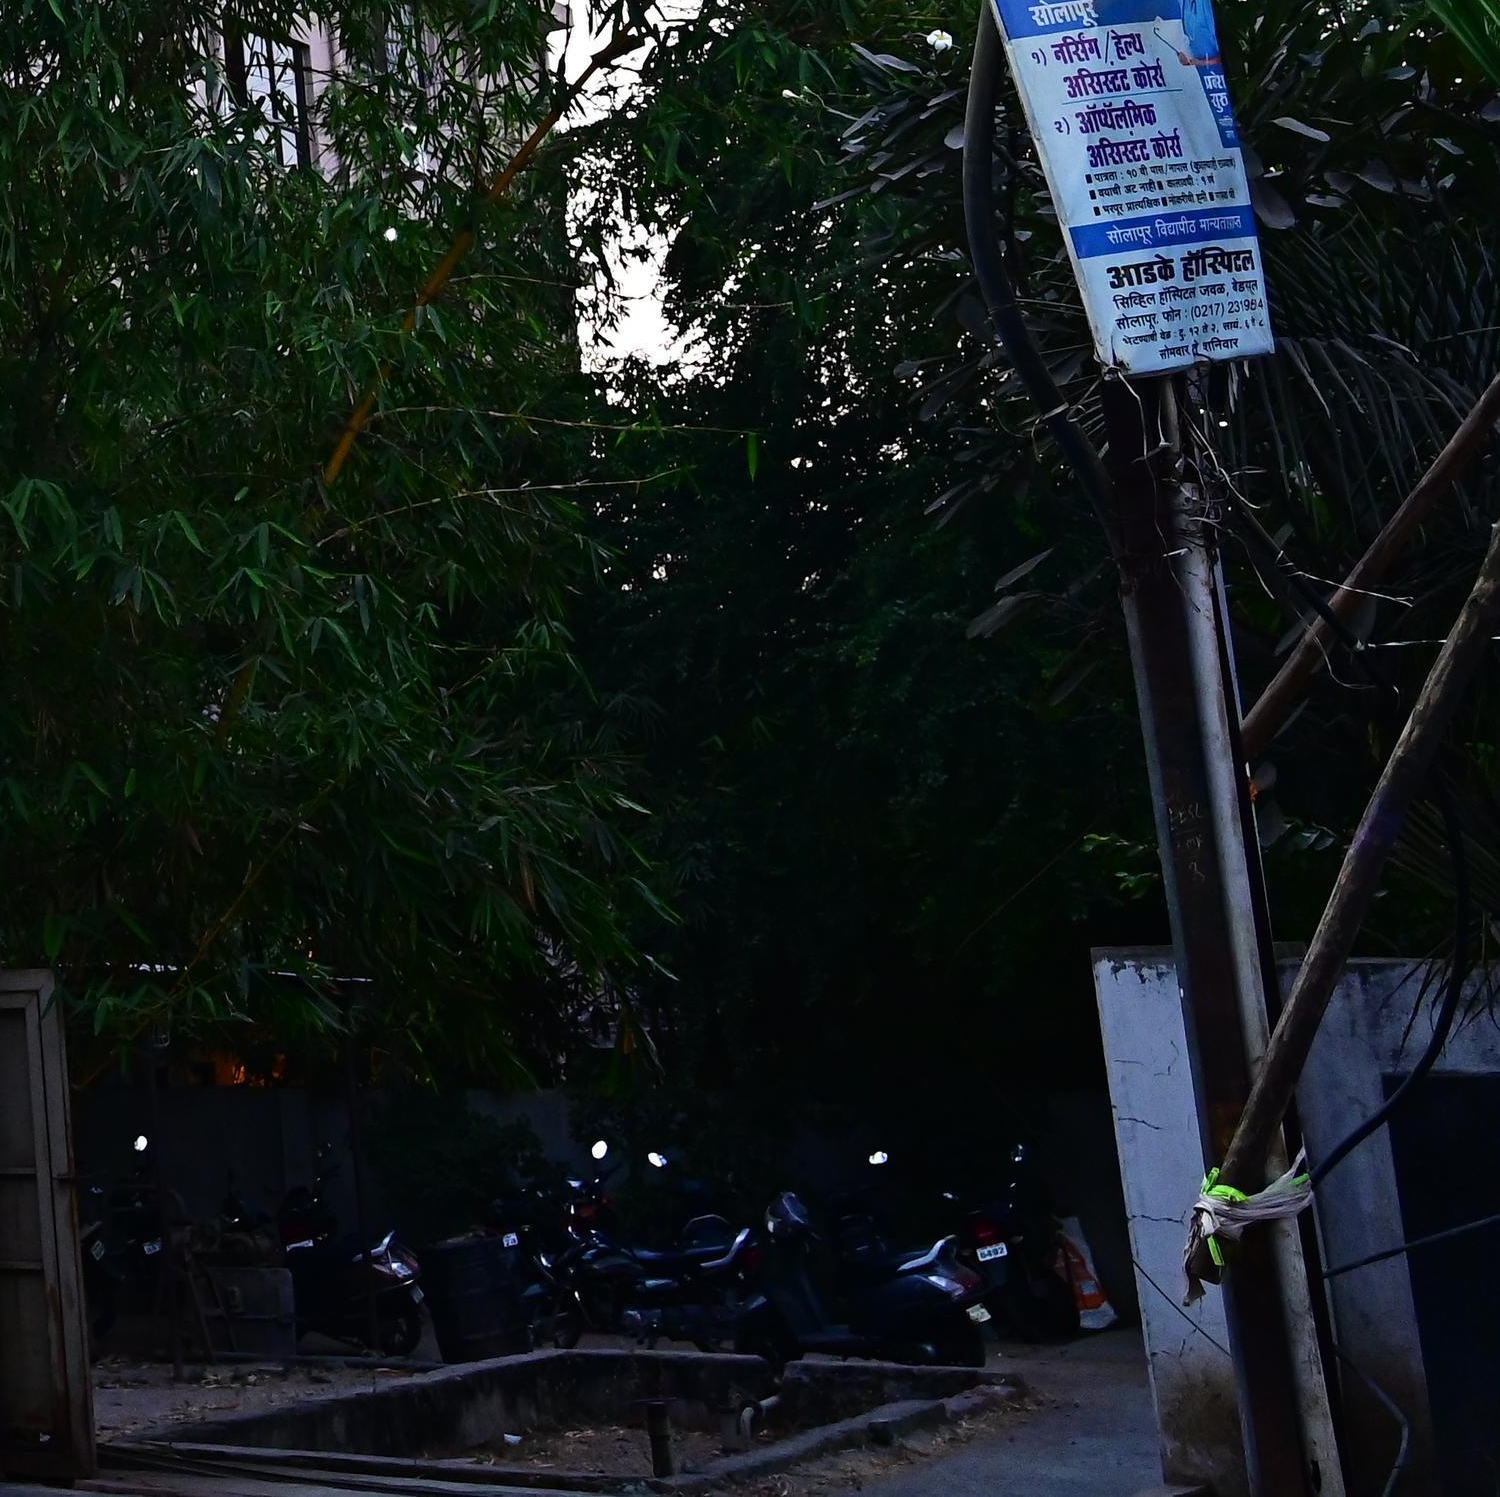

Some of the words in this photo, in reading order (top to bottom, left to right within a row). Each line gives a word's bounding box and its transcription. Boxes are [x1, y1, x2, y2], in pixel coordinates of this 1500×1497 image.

[1105, 224, 1153, 246] सोलापूर
[1106, 253, 1176, 289] आडके
[1180, 246, 1256, 282] हॉस्पिटल
[1159, 286, 1196, 306] हॉस्पिटल
[1162, 306, 1181, 324] फोन
[1191, 303, 1225, 322] (0217)
[1202, 336, 1239, 353] शनिवार
